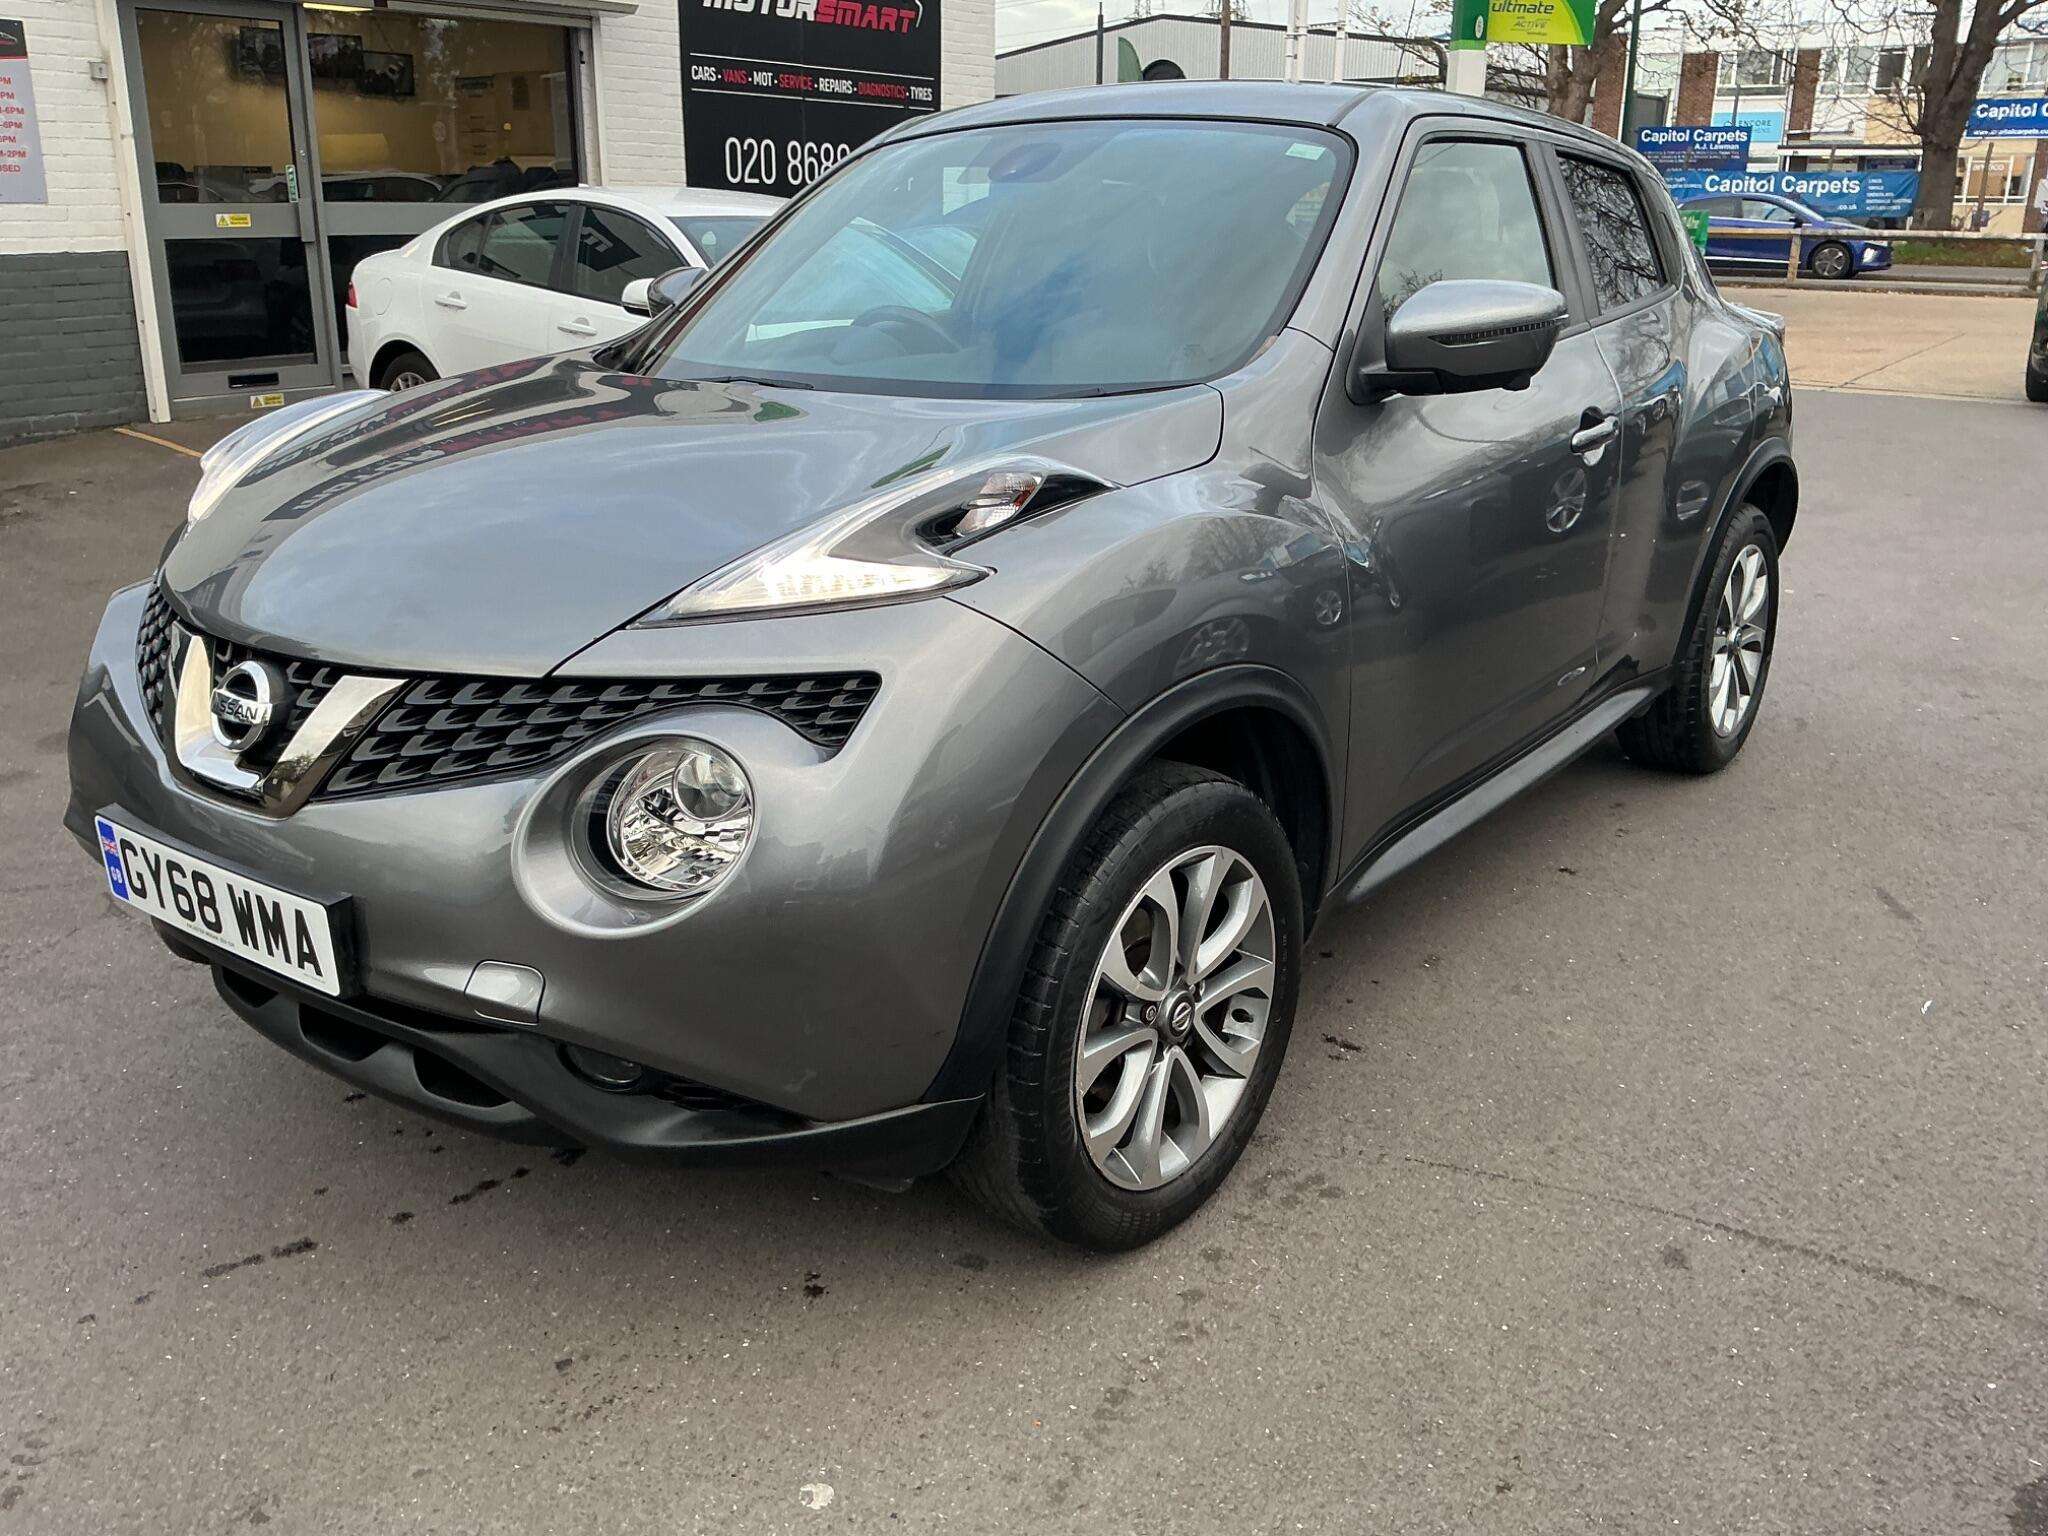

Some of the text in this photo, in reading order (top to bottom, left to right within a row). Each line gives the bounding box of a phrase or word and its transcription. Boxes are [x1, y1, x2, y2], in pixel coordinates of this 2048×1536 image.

[691, 65, 933, 101] CARS VANS MOT SERVICE REPAIRS DIAGNOSTICS TYRES
[1976, 102, 2038, 120] Capitol
[1641, 129, 1748, 144] Capitol Carpets
[725, 137, 776, 185] 020
[1705, 174, 1860, 197] Capitol Carpets
[119, 838, 323, 977] GY68 WMA
